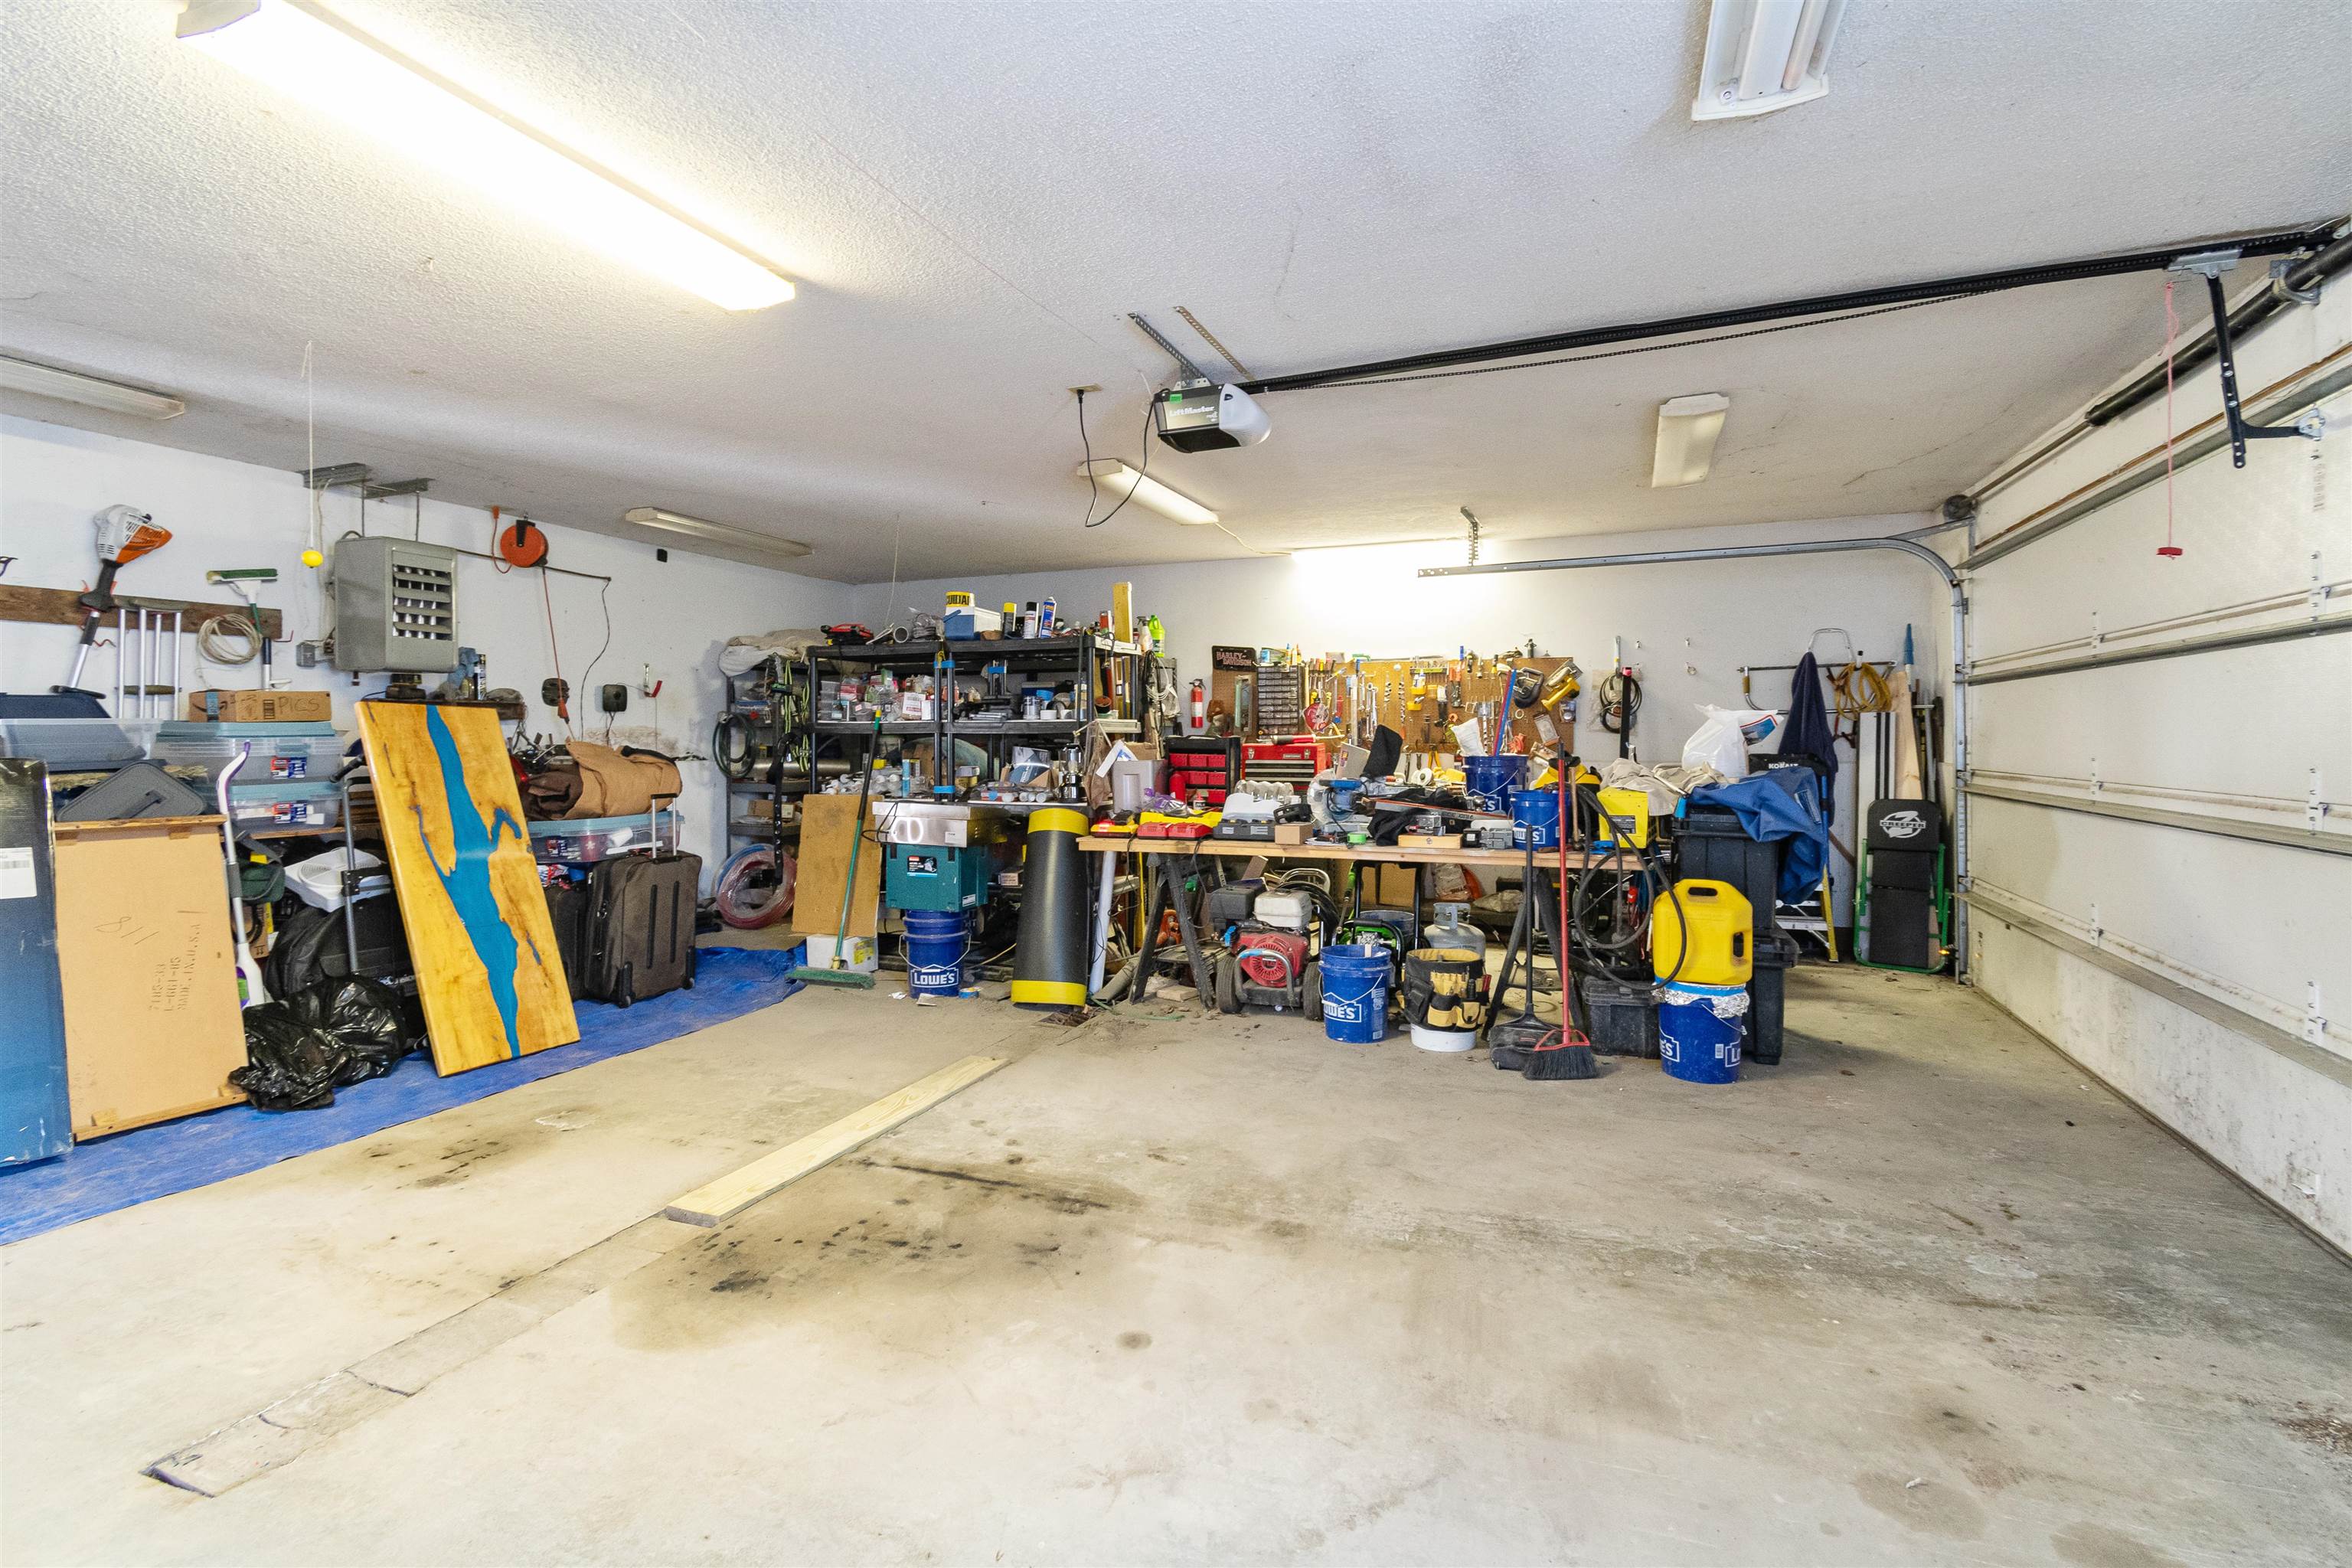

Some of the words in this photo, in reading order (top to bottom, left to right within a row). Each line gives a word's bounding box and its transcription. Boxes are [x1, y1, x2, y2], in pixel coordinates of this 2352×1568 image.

[278, 696, 320, 714] PICS
[1880, 820, 1926, 828] CREEPER
[914, 972, 955, 985] LOWE'S
